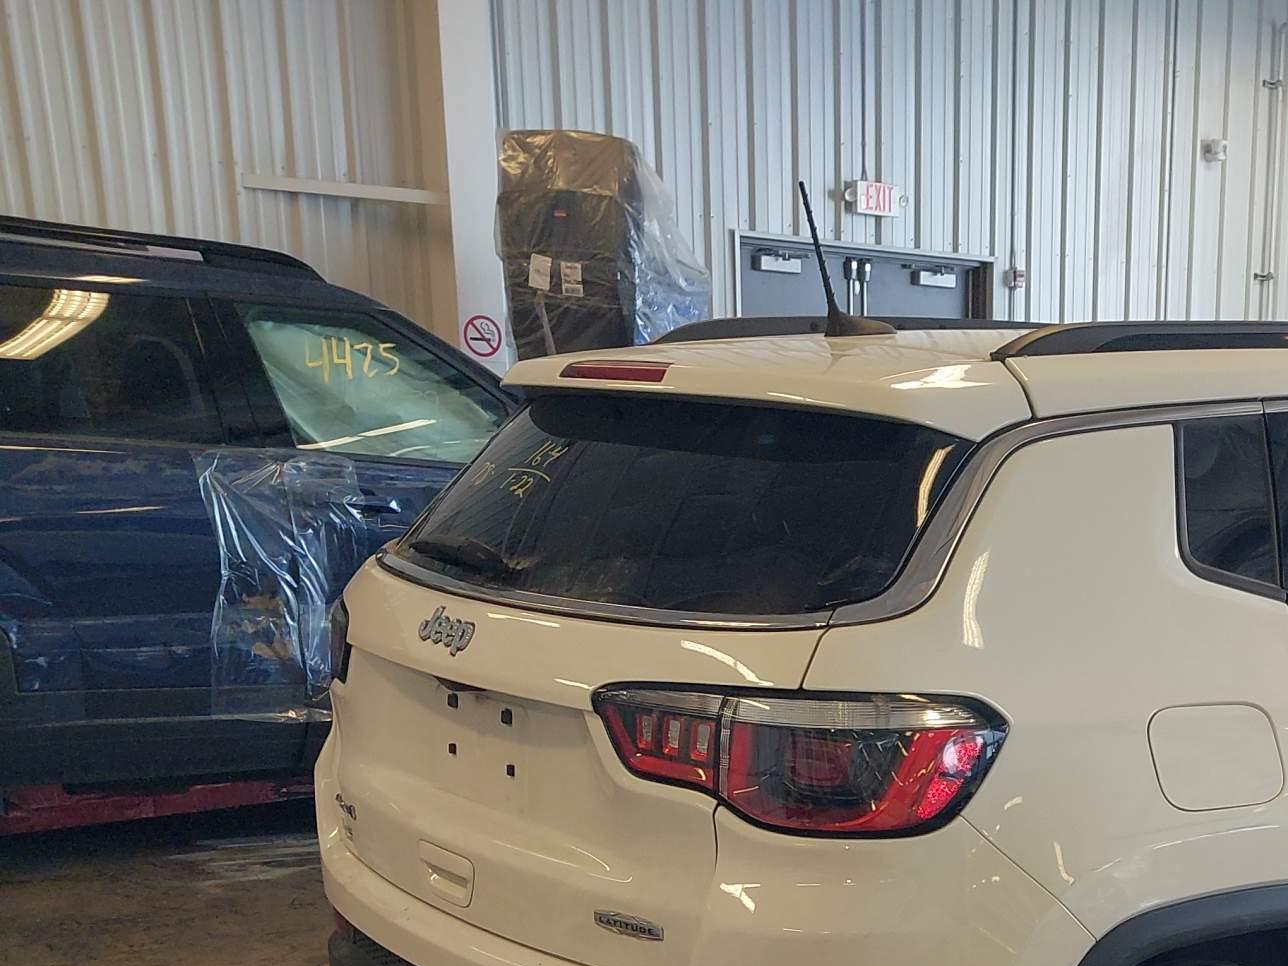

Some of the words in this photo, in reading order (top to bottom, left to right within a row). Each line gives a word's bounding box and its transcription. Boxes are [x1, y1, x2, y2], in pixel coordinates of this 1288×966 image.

[864, 183, 894, 213] EXIT
[418, 605, 476, 657] Jeep
[598, 915, 656, 937] LATITUDE
